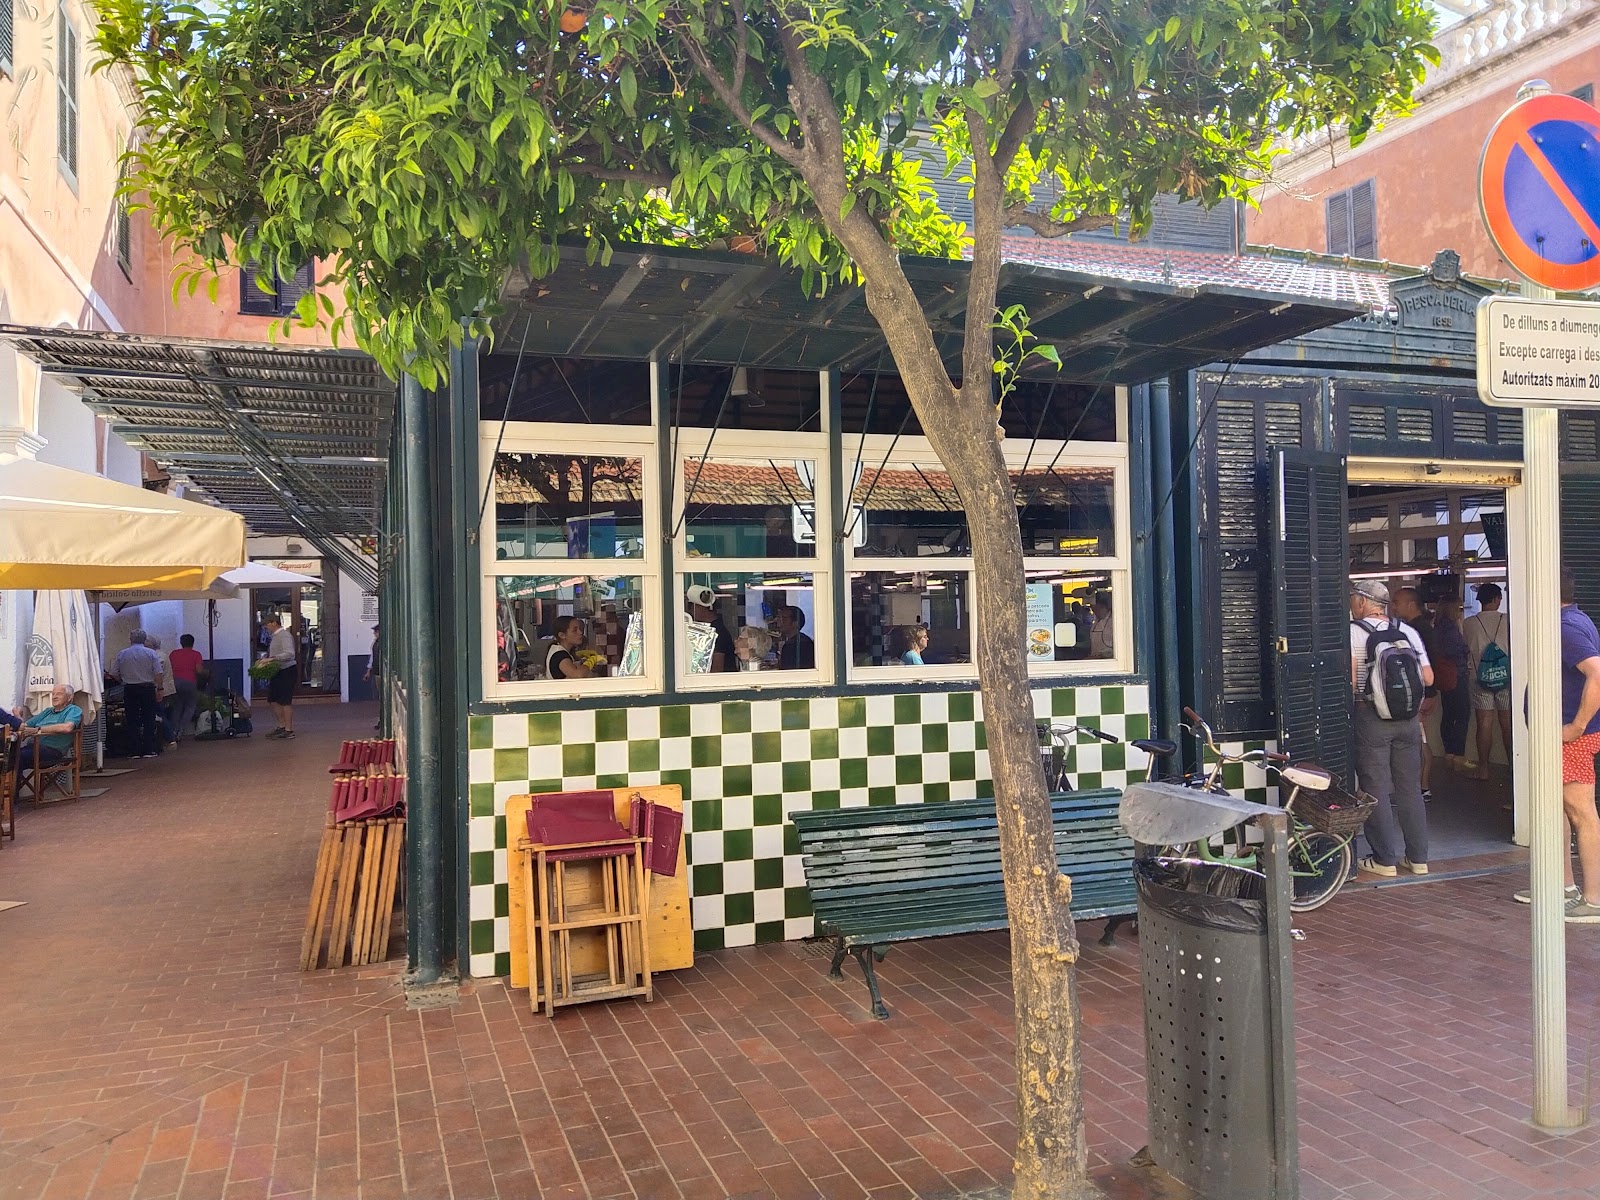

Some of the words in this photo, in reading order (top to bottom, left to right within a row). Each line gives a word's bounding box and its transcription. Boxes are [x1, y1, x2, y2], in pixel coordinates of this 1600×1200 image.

[1404, 294, 1476, 317] PESCADERIA
[1503, 313, 1516, 329] De
[1518, 315, 1549, 332] dilluns
[1551, 320, 1558, 332] a
[1560, 317, 1600, 338] diumeng
[1500, 341, 1538, 361] Excepte
[1540, 347, 1576, 364] carrega
[1579, 346, 1582, 361] i
[1502, 370, 1554, 387] Autoritzats
[1556, 373, 1587, 389] màxim
[1589, 373, 1600, 389] 20
[30, 676, 55, 686] Galicia
